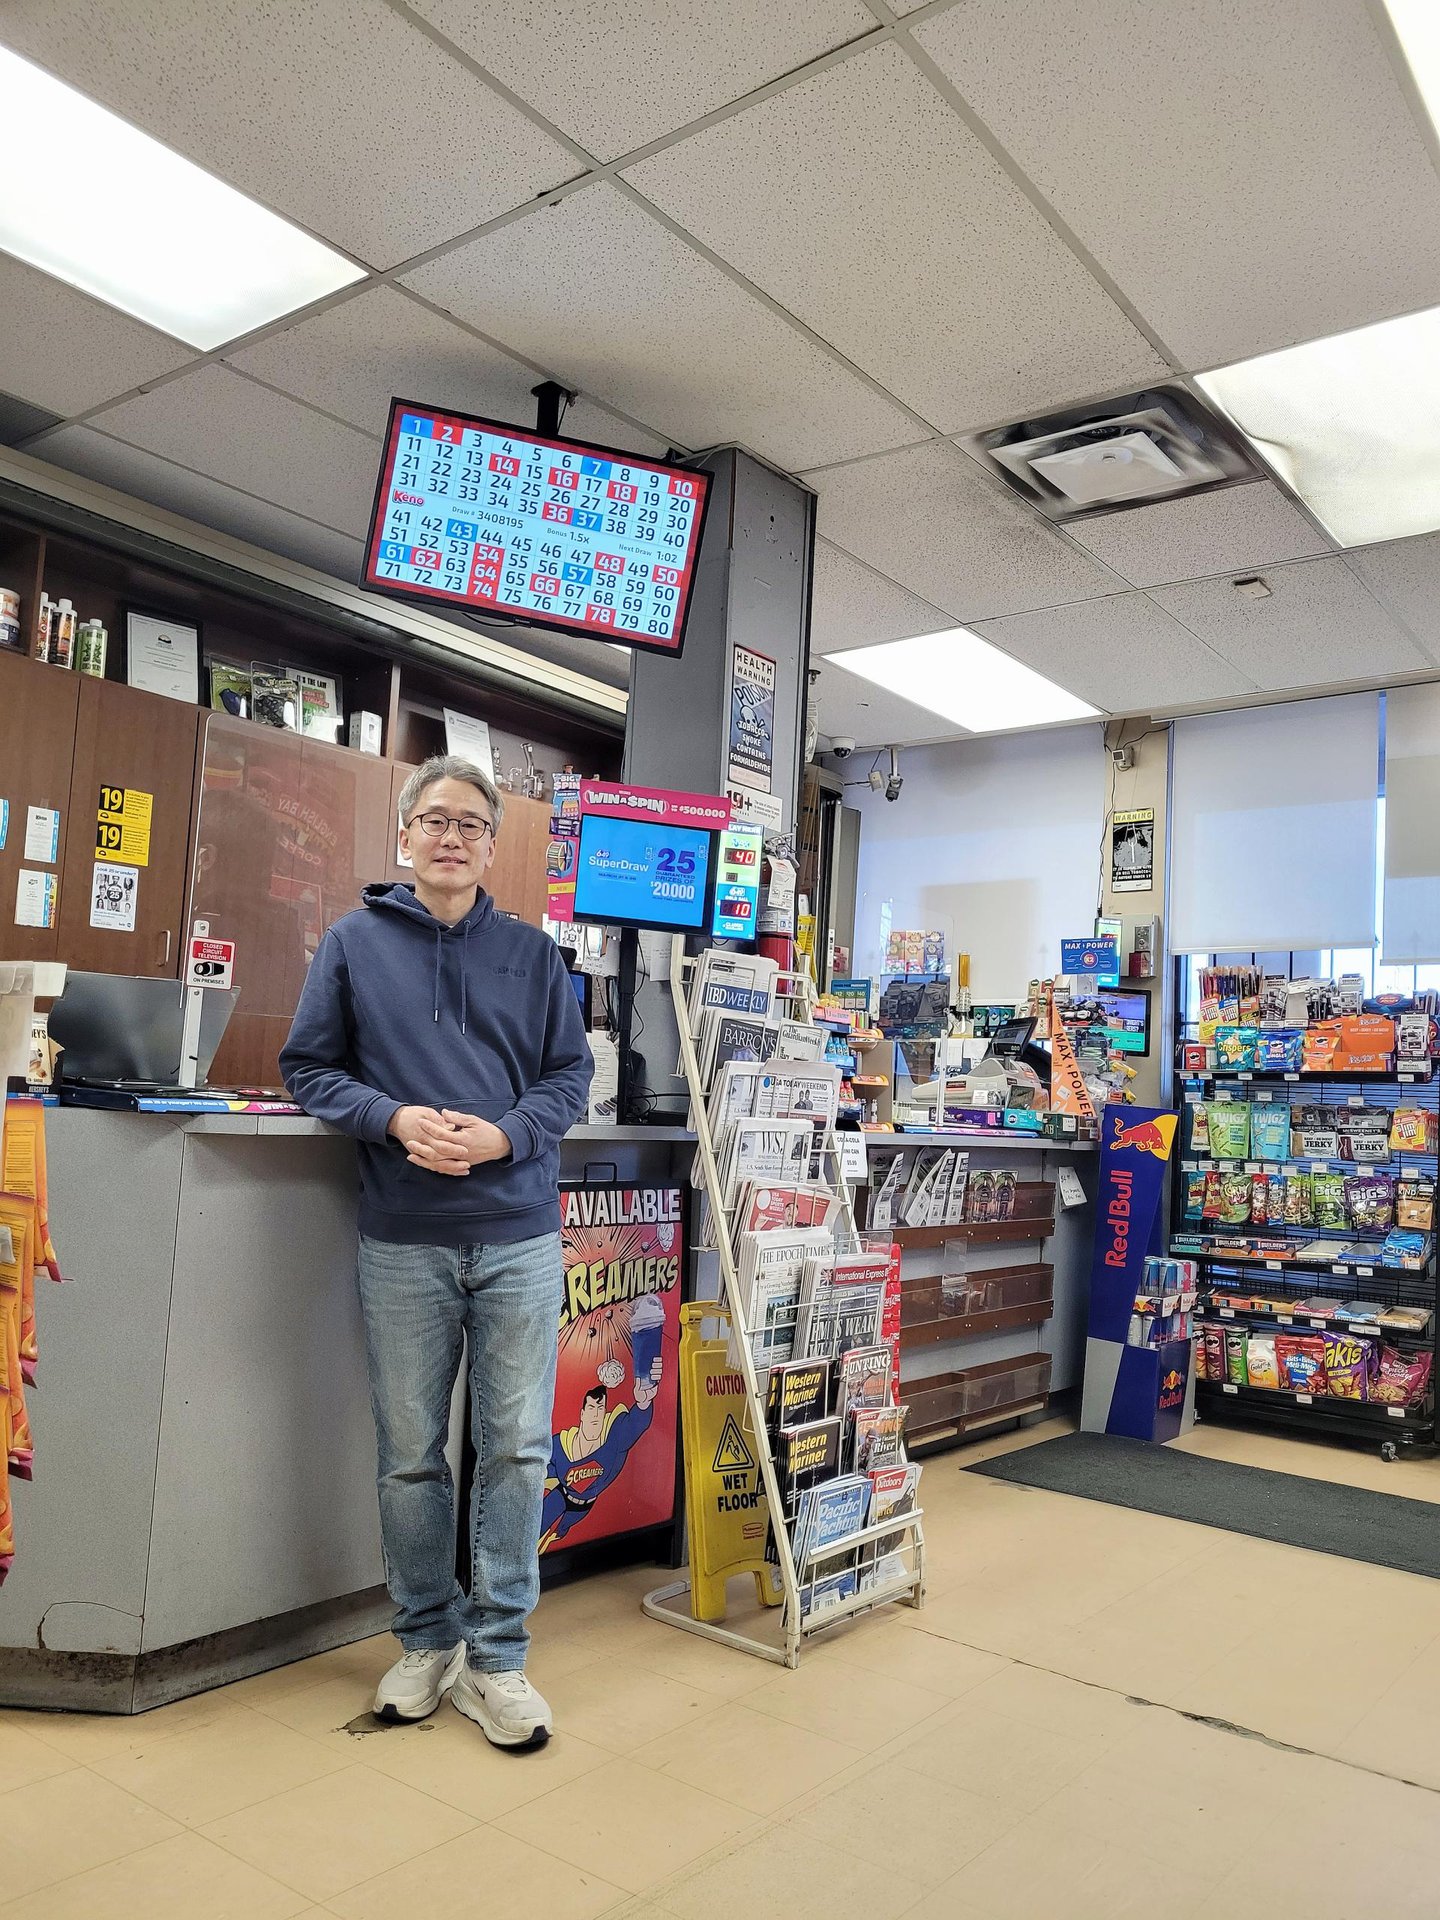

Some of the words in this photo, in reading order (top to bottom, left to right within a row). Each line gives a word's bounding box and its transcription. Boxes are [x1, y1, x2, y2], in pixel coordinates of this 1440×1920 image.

[413, 420, 421, 434] 1
[442, 426, 452, 441] 2
[473, 434, 482, 447] 3
[502, 441, 512, 454] 4
[532, 448, 542, 461] 5
[562, 455, 571, 468] 6
[593, 461, 602, 472] 7
[621, 469, 630, 481] 8
[650, 475, 658, 488] 9
[674, 481, 692, 496] 10
[408, 437, 421, 451] 11
[437, 444, 453, 459] 12
[467, 451, 483, 465] 13
[496, 457, 513, 473] 14
[527, 465, 542, 479] 15
[555, 471, 572, 486] 16
[586, 478, 602, 492] 17
[614, 484, 631, 500] 18
[644, 492, 659, 506] 19
[670, 498, 690, 513] 20
[392, 489, 425, 507] Keno
[402, 454, 419, 469] 21
[431, 461, 451, 477] 22
[461, 468, 481, 483] 23
[491, 475, 511, 490] 24
[521, 482, 541, 497] 25
[550, 488, 570, 504] 26
[580, 495, 600, 510] 27
[609, 502, 629, 517] 28
[638, 508, 657, 523] 29
[667, 515, 686, 530] 30
[399, 472, 416, 487] 31
[428, 478, 448, 494] 32
[458, 485, 478, 501] 33
[488, 492, 508, 508] 34
[518, 499, 538, 514] 35
[547, 505, 568, 521] 36
[577, 513, 596, 526] 37
[606, 519, 626, 534] 38
[635, 526, 654, 540] 39
[664, 533, 684, 547] 40
[452, 506, 470, 515] Draw
[477, 510, 524, 529] 3408195
[547, 528, 568, 537] Bonus
[392, 510, 410, 524] 41
[421, 516, 442, 532] 42
[452, 525, 472, 538] 43
[481, 530, 502, 545] 44
[511, 536, 532, 551] 45
[541, 543, 561, 558] 46
[571, 550, 591, 564] 47
[598, 556, 620, 572] 48
[628, 563, 648, 577] 49
[656, 568, 678, 584] 50
[618, 544, 634, 554] Next
[635, 548, 652, 556] Draw
[656, 550, 677, 563] 1:02
[390, 527, 406, 542] 51
[419, 533, 438, 549] 52
[449, 540, 468, 555] 53
[478, 546, 499, 562] 54
[509, 554, 528, 568] 55
[538, 560, 557, 575] 56
[569, 567, 587, 580] 57
[596, 573, 616, 588] 58
[626, 579, 644, 594] 59
[655, 586, 674, 600] 60
[387, 545, 404, 559] 61
[415, 550, 436, 567] 62
[446, 558, 465, 573] 63
[475, 564, 496, 580] 64
[506, 571, 525, 586] 65
[535, 577, 555, 593] 66
[566, 584, 584, 598] 67
[594, 590, 613, 605] 68
[623, 597, 642, 611] 69
[653, 603, 670, 617] 70
[385, 562, 400, 576] 71
[414, 568, 432, 584] 72
[445, 575, 462, 590] 73
[473, 581, 492, 597] 74
[504, 588, 522, 603] 75
[534, 594, 551, 609] 76
[564, 601, 580, 615] 77
[591, 606, 610, 623] 78
[621, 614, 638, 628] 79
[648, 620, 668, 634] 80
[736, 652, 773, 675] HEALTH
[736, 665, 771, 686] WARNING
[734, 681, 772, 706] POISON
[738, 721, 764, 737] TOBACCO
[742, 734, 761, 746] SMOKE
[736, 743, 766, 760] CONTAINS
[730, 752, 771, 774] FORMALDEHYDE
[101, 788, 123, 810] 19
[1115, 812, 1151, 821] WARNING
[99, 825, 120, 848] 19
[588, 856, 648, 872] SuperDraw
[657, 847, 695, 874] 25
[736, 851, 754, 864] 40
[736, 904, 750, 916] 10
[722, 1027, 777, 1052] BARRON'S
[1218, 1041, 1250, 1052] Crispers
[801, 1079, 827, 1091] WEEKEND
[1054, 1032, 1072, 1060] MAX
[1068, 1070, 1094, 1116] POWER
[1212, 1113, 1249, 1124] TWIGZ
[1254, 1114, 1285, 1125] TWIGZ
[1108, 1170, 1133, 1216] Bull
[564, 1189, 680, 1227] AVAILABLE
[1104, 1218, 1129, 1267] Red
[775, 1249, 803, 1261] EPOCH
[835, 1271, 865, 1280] International
[867, 1269, 885, 1279] Express
[559, 1256, 679, 1329] REAMERS
[843, 1354, 891, 1377] HUNTING
[706, 1374, 747, 1396] CAUTION
[785, 1372, 821, 1390] Western
[784, 1386, 819, 1406] Mariner
[790, 1433, 827, 1457] Western
[874, 1441, 896, 1454] River
[789, 1449, 827, 1473] Mariner
[566, 1466, 604, 1486] SCREAMERS
[722, 1473, 747, 1491] WET
[876, 1477, 902, 1489] Outdoors
[717, 1492, 758, 1512] FLOOR
[820, 1497, 860, 1520] Pacific
